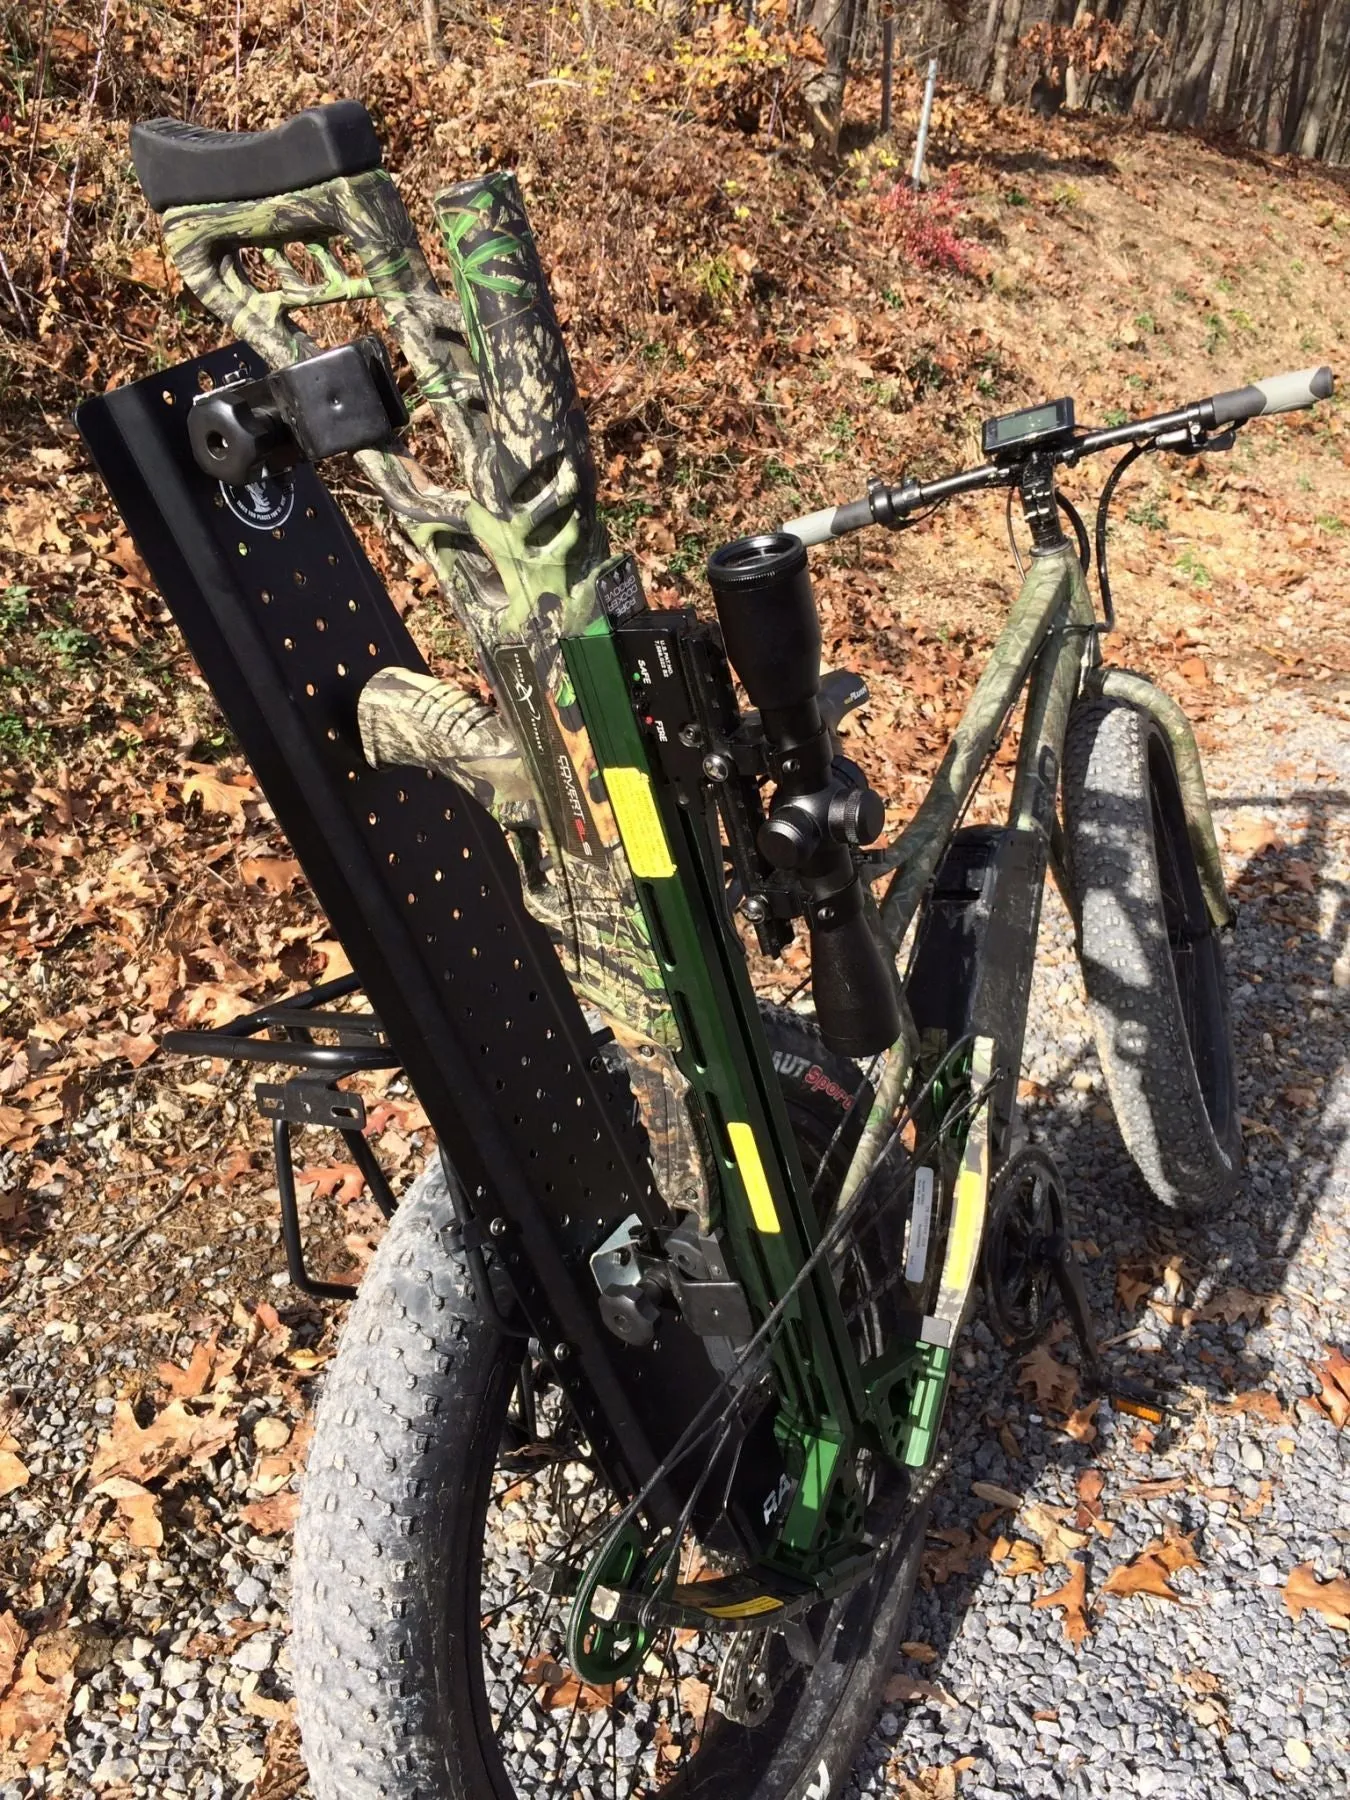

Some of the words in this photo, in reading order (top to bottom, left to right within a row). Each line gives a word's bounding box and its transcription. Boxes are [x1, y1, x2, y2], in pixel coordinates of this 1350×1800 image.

[604, 575, 636, 602] GROOVE
[608, 583, 638, 612] COCKER
[615, 597, 637, 617] ROPE
[638, 659, 652, 685] SAFE
[654, 720, 668, 742] FIRE
[558, 755, 586, 824] COVERT
